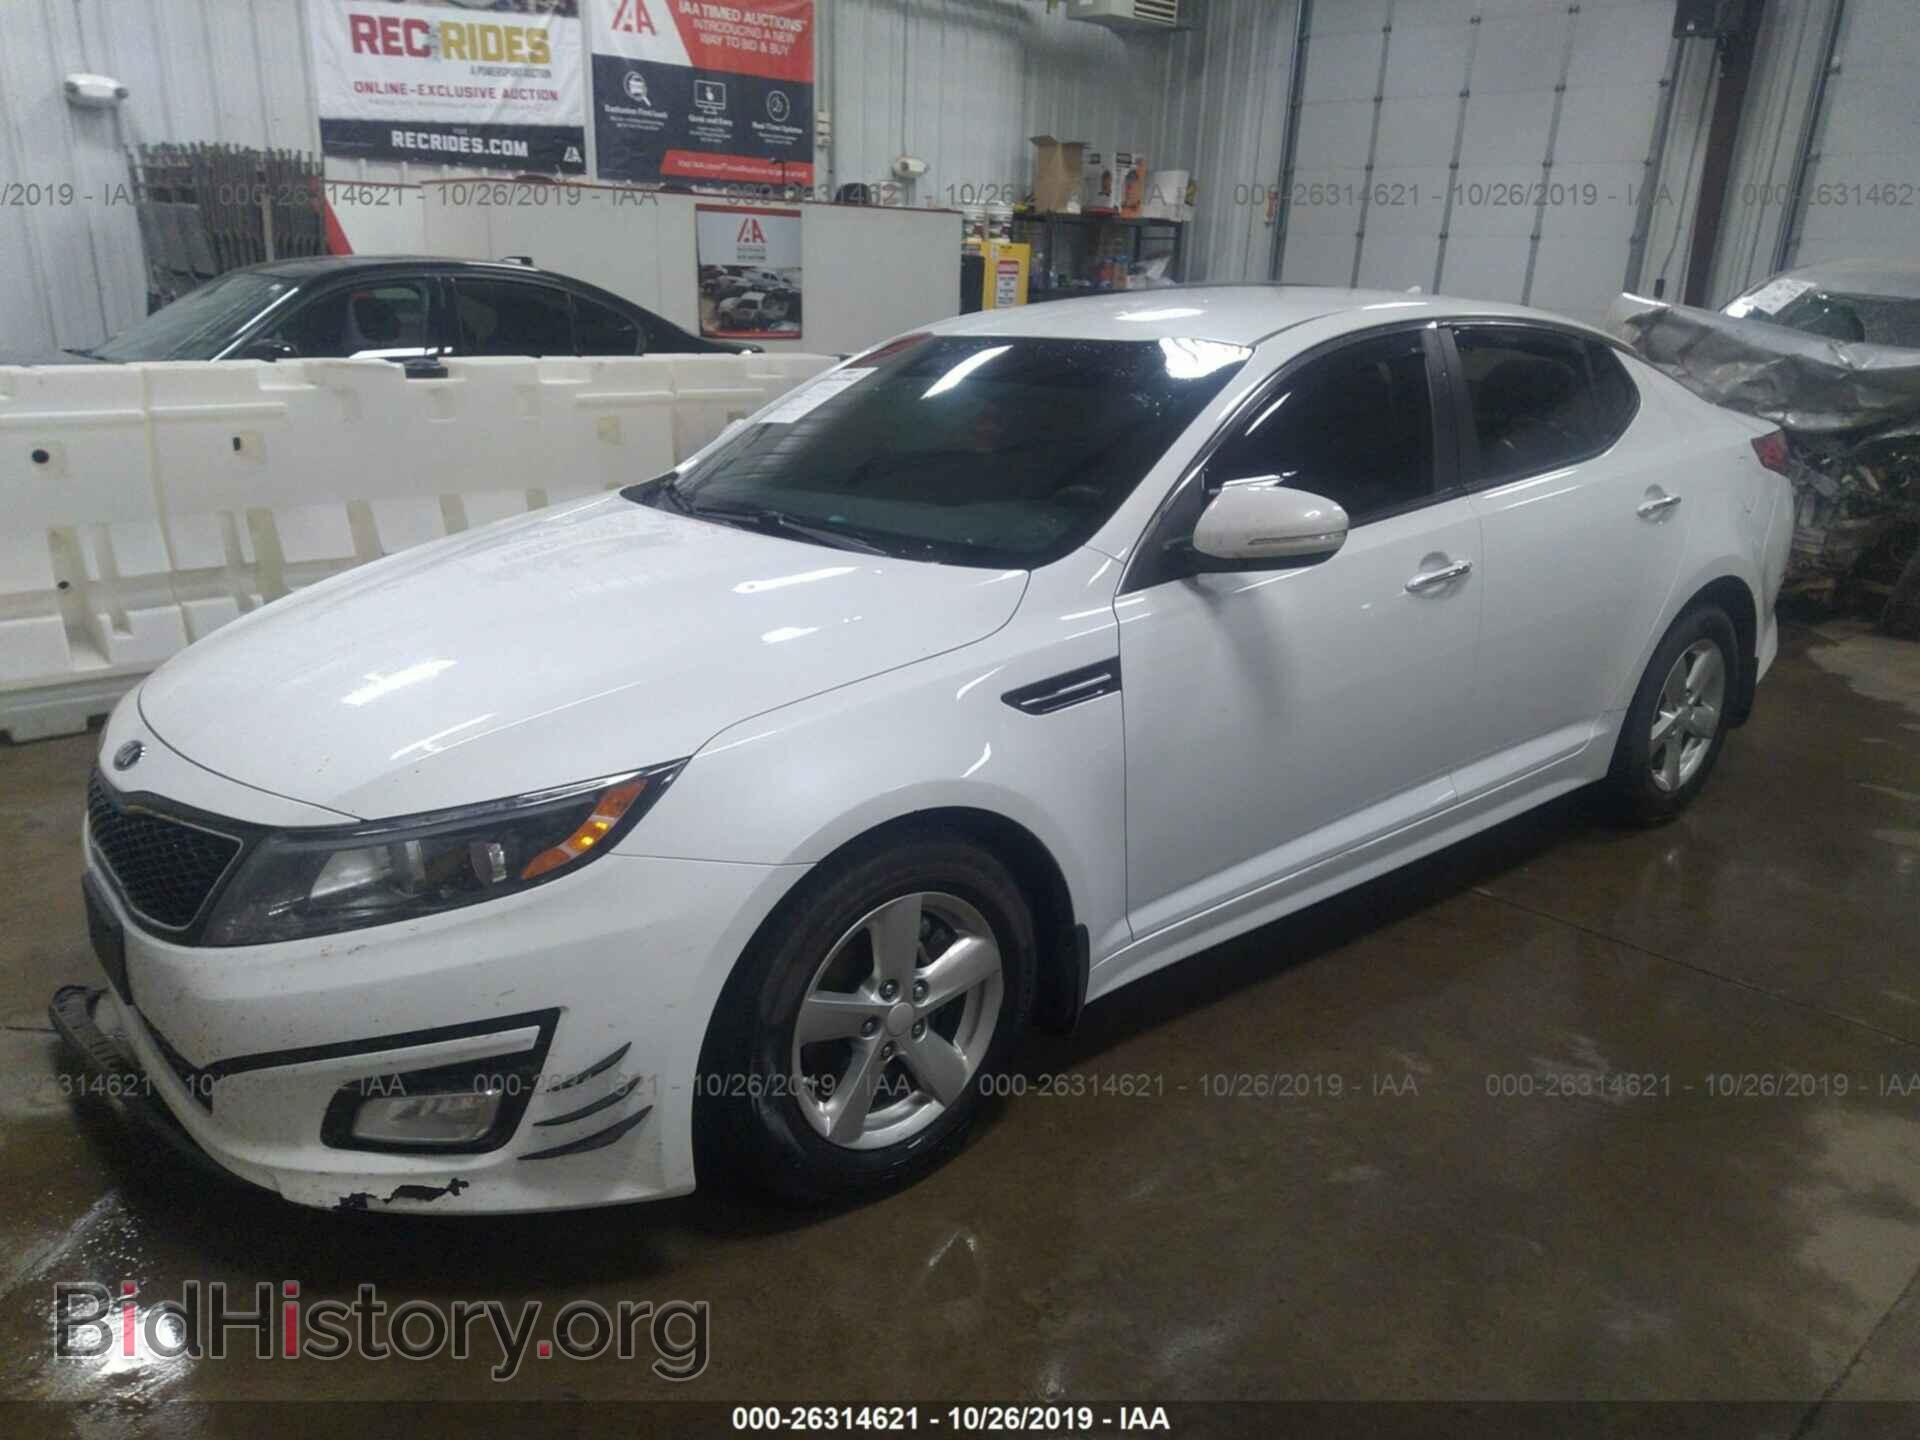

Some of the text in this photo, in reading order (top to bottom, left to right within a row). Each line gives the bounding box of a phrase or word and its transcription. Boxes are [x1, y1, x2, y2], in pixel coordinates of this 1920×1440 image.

[349, 14, 552, 64] REC RIDES
[354, 80, 559, 101] ONLINE-EXCLUSIVE AUCTION
[391, 131, 528, 157] RECRIDES.COM
